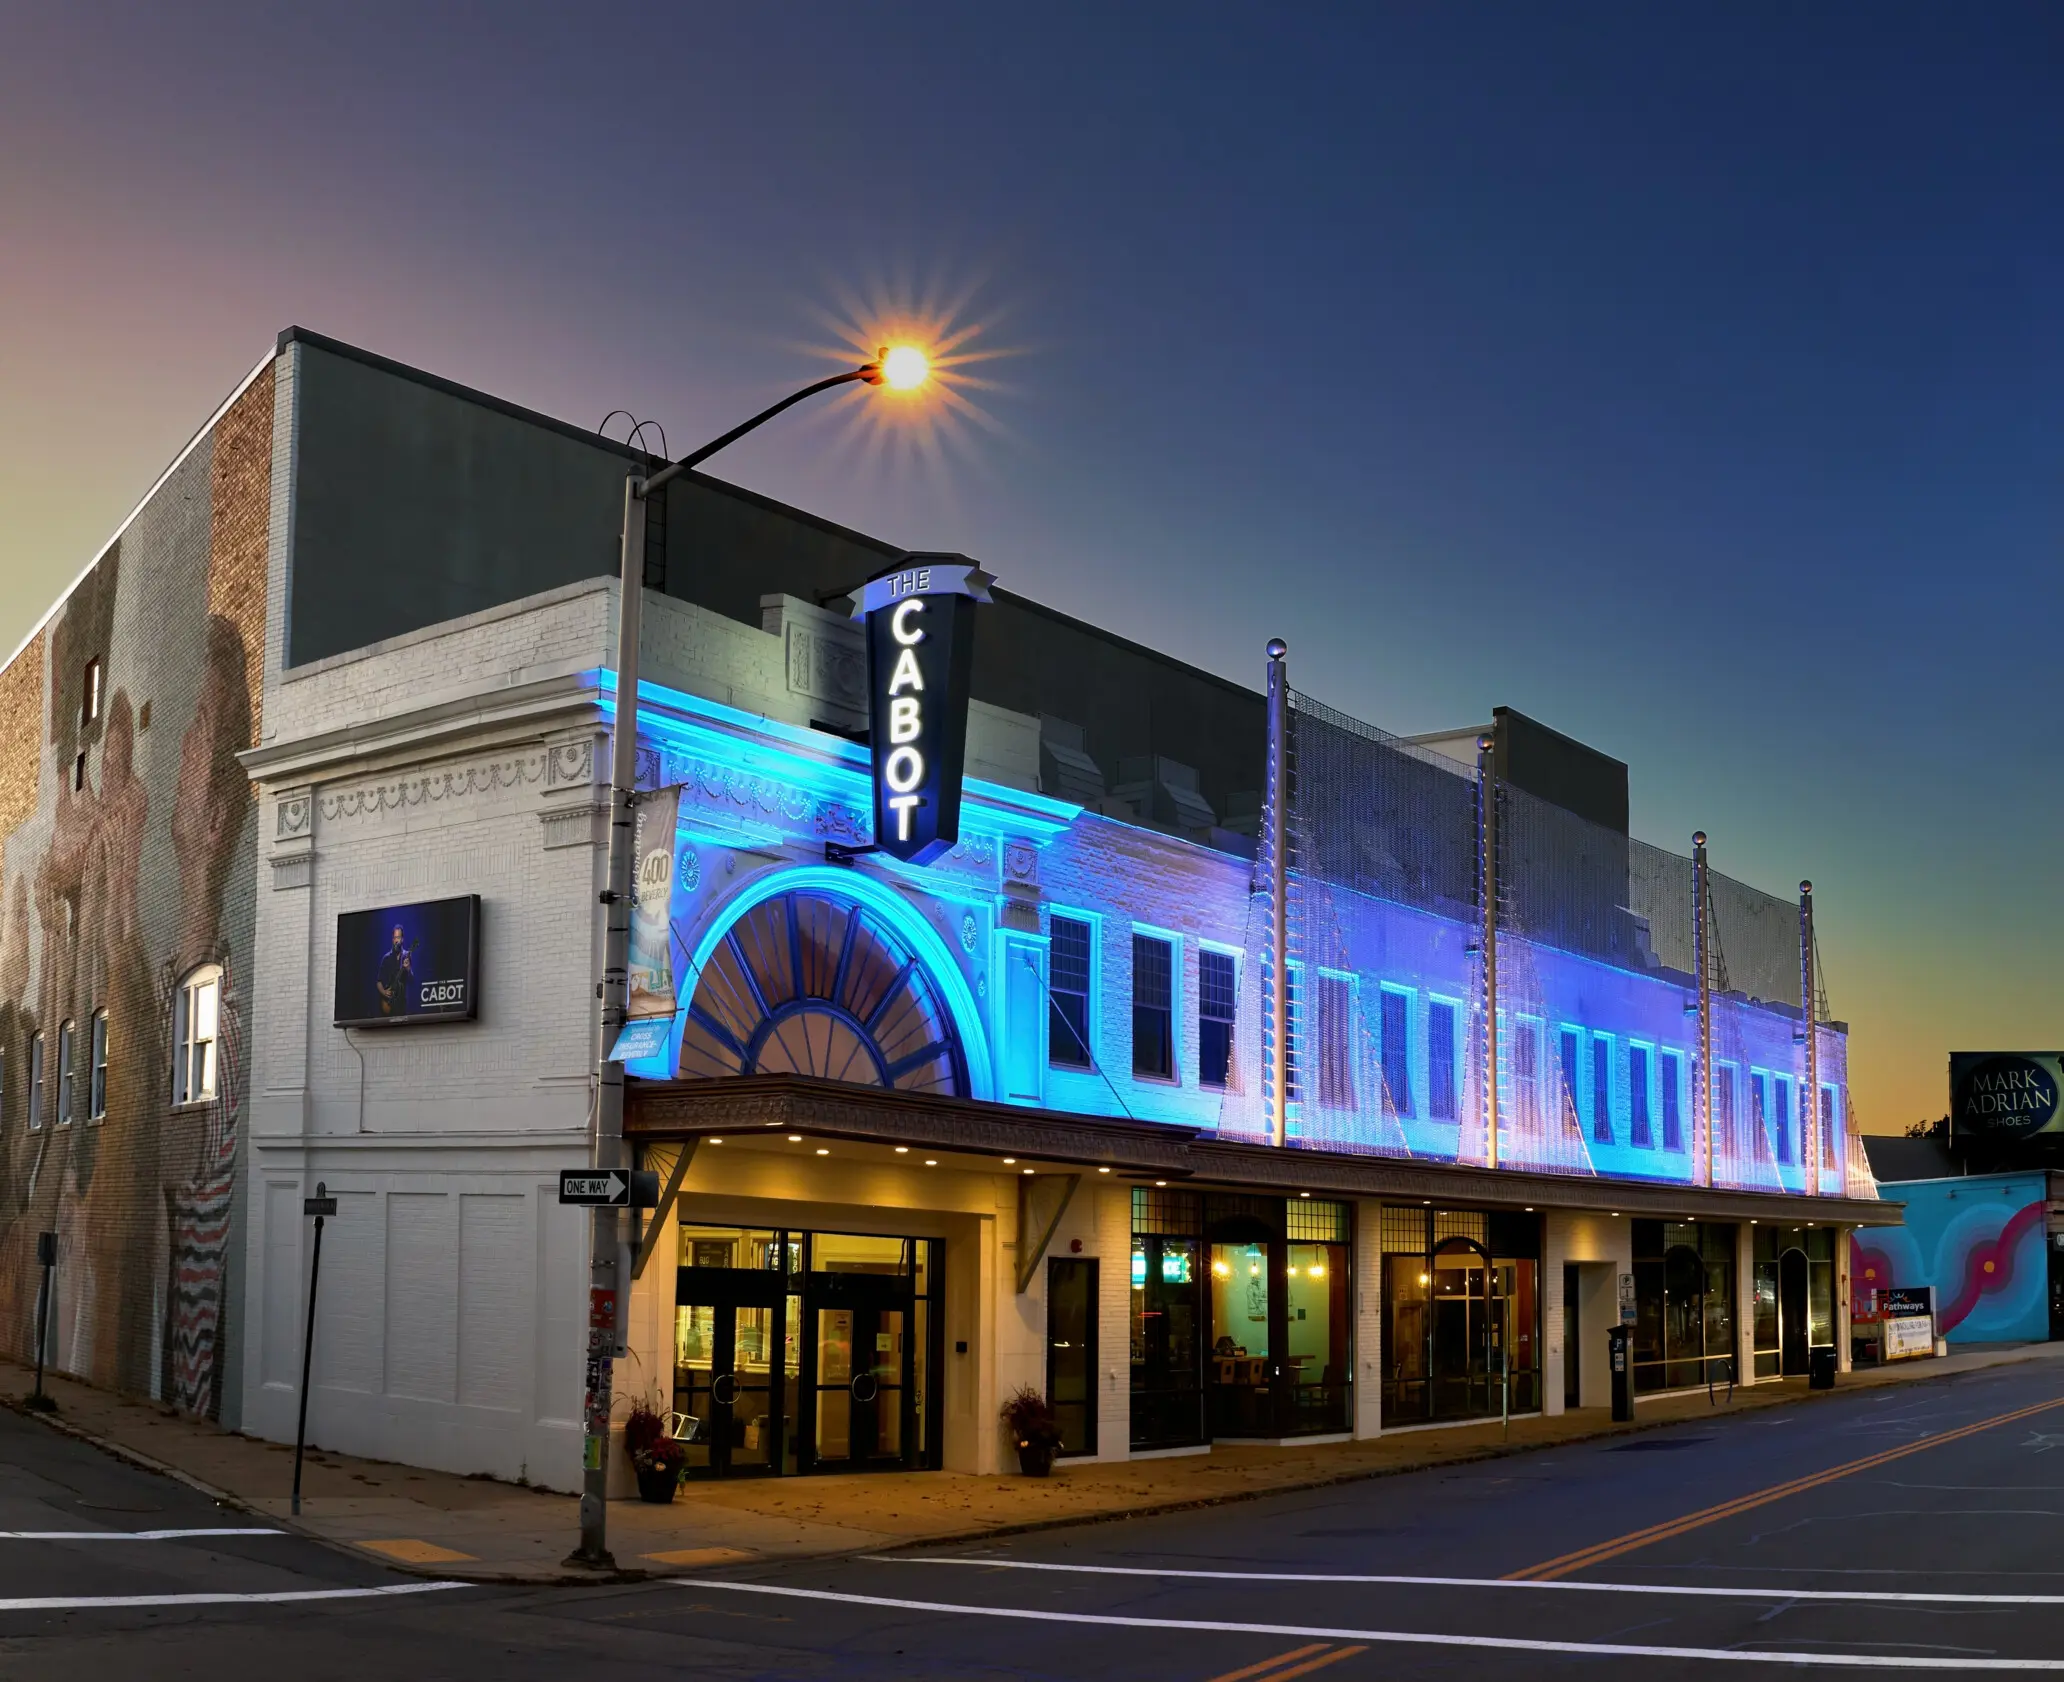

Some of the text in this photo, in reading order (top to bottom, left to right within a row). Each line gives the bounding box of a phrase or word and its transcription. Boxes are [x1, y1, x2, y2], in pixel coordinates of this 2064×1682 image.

[887, 569, 930, 597] THE
[885, 598, 926, 842] CABOT
[642, 855, 669, 885] 400
[641, 887, 669, 902] BEVERLY
[421, 985, 464, 1002] CABOT
[1973, 1069, 2040, 1094] MARK
[1965, 1088, 2051, 1115] ADRIAN
[1987, 1115, 2031, 1128] SHOES
[566, 1180, 609, 1194] ONE WAY
[1883, 1302, 1924, 1311] Pathways
